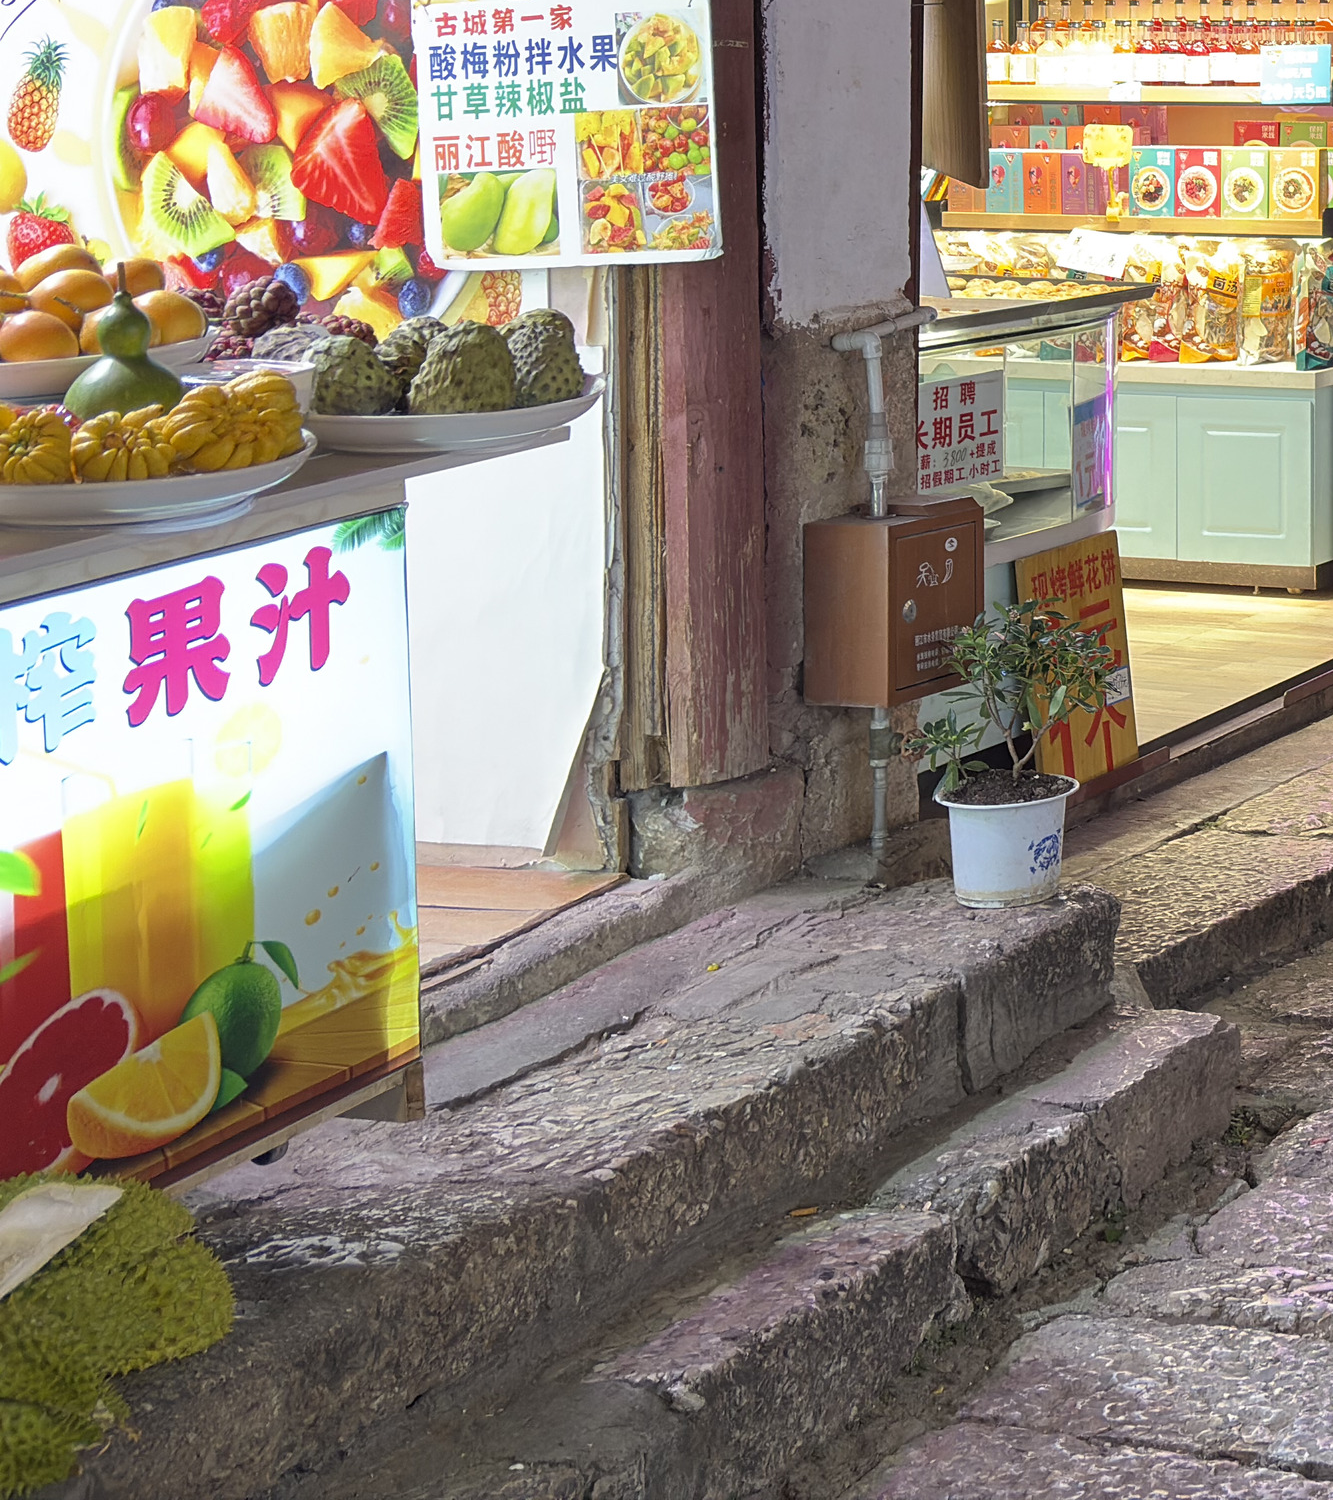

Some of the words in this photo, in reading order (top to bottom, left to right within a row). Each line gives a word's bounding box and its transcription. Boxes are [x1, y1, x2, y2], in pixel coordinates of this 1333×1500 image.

[435, 4, 573, 38] 古城第一家
[429, 34, 618, 81] 酸梅粉拌水果
[431, 77, 587, 121] 甘草辣椒盐
[433, 129, 556, 171] 丽江酸嘢
[933, 380, 976, 411] 招聘
[917, 409, 999, 450] 长期员工
[1031, 548, 1116, 608] 现烤鲜花饼
